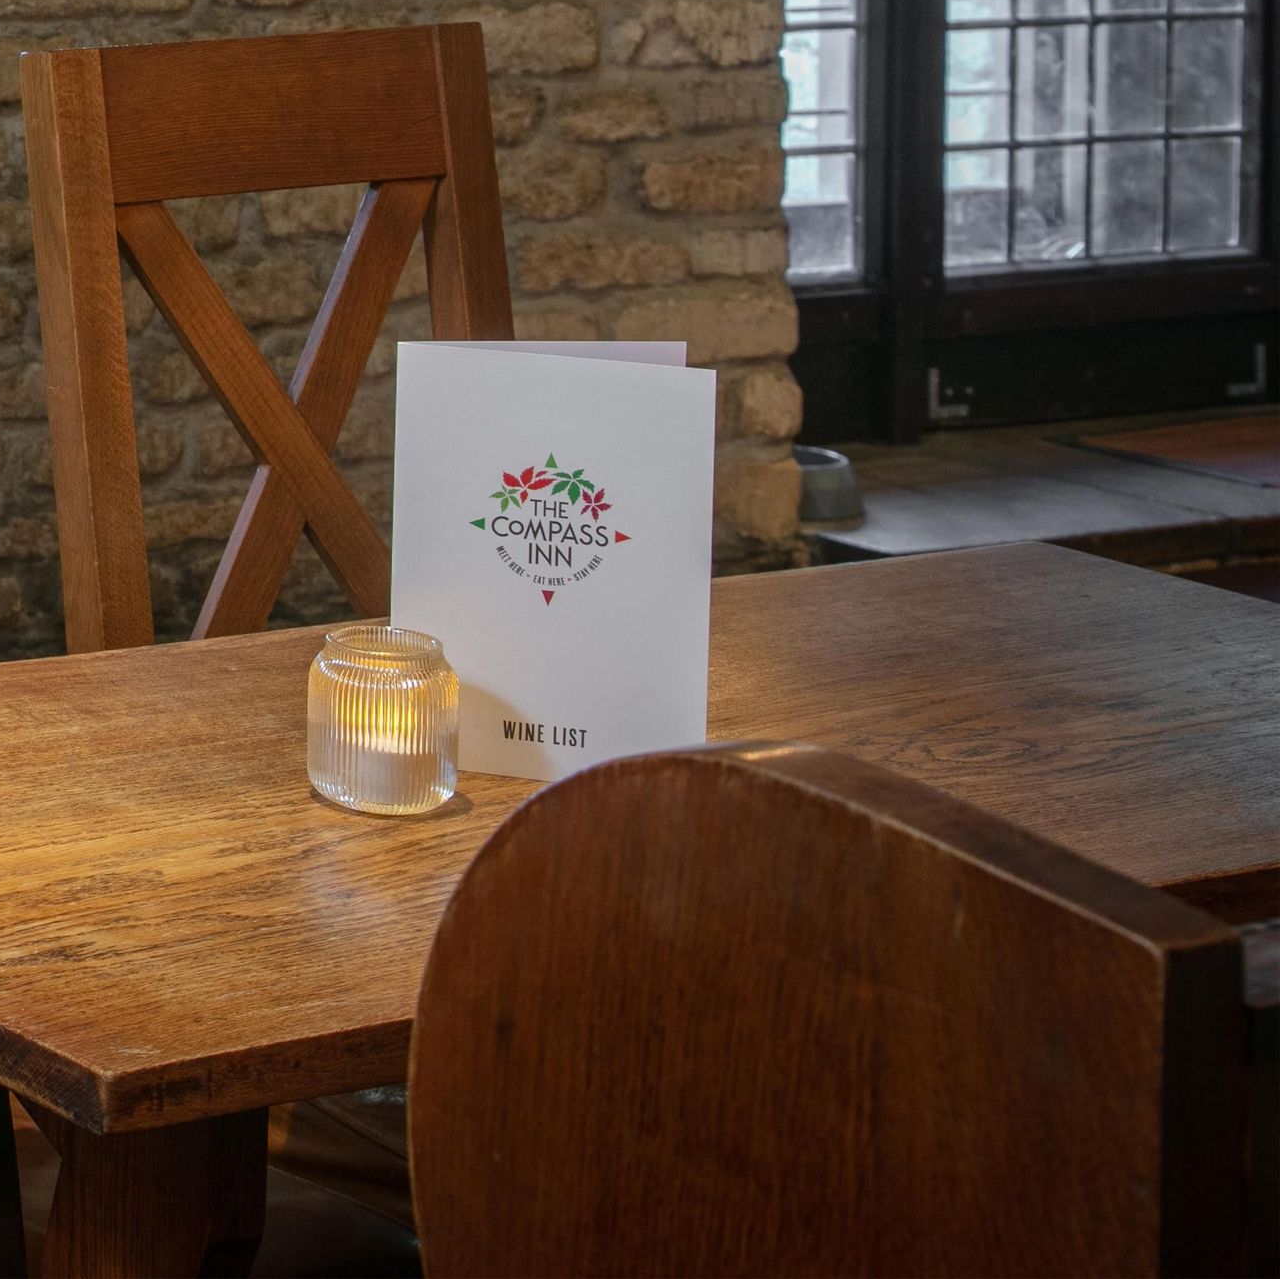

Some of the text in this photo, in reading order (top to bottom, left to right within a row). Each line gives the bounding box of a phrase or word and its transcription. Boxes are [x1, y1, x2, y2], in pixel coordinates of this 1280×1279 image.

[530, 499, 569, 519] THE
[491, 516, 609, 547] COMPASS
[495, 545, 604, 586] MEET HERE EAT HERE STAY HERE
[528, 542, 572, 568] INN
[503, 720, 587, 748] WINE LIST
